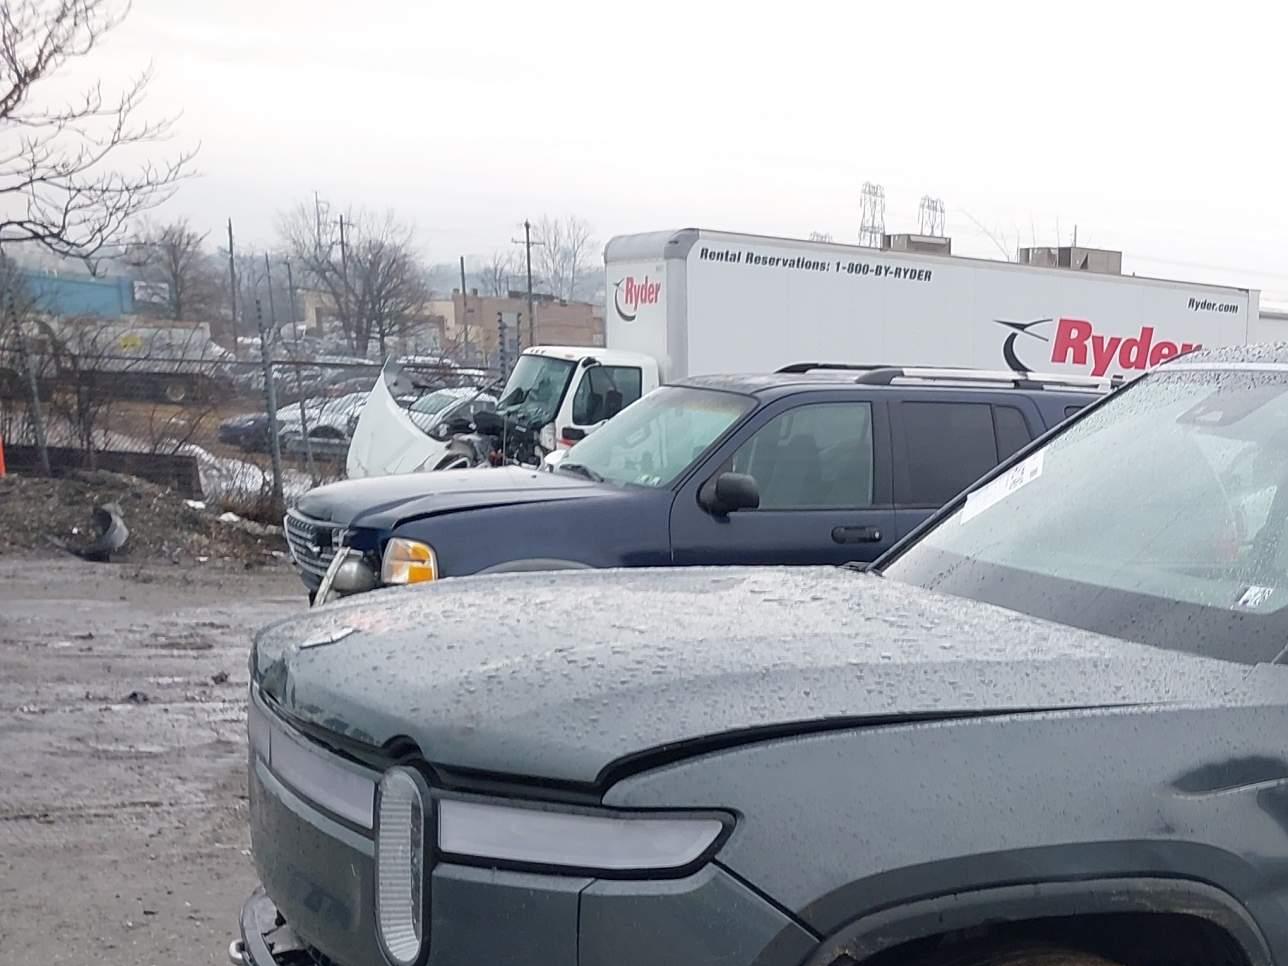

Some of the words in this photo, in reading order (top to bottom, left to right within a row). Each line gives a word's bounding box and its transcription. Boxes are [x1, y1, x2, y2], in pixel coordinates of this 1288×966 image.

[700, 247, 742, 264] Rental
[745, 252, 831, 272] Reservations:
[835, 261, 933, 282] 1-800-BY-RYDER
[624, 275, 661, 312] Ryder
[1188, 298, 1239, 313] Ryder.com
